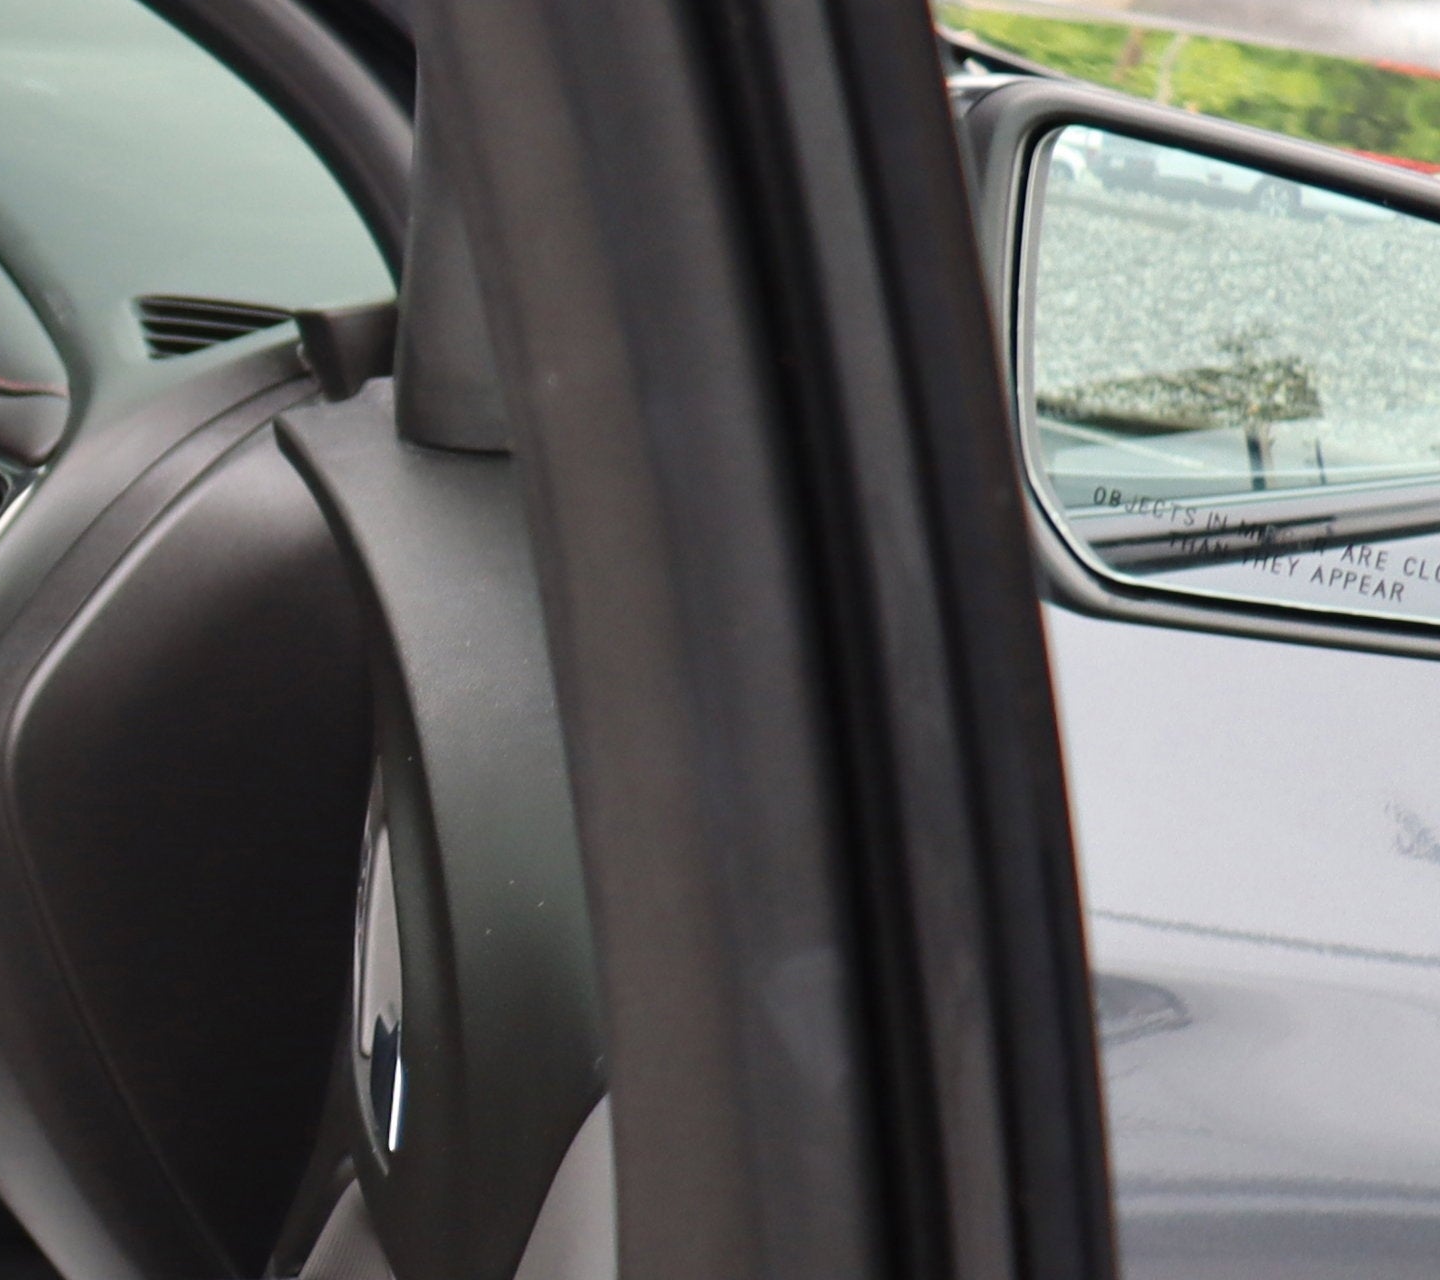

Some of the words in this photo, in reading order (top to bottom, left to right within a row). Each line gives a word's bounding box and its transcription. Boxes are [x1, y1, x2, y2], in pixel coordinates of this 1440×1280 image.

[1092, 485, 1199, 528] OBJECTS
[1206, 510, 1229, 532] IN
[1339, 542, 1390, 572] ARE
[1309, 564, 1407, 604] APPEAR
